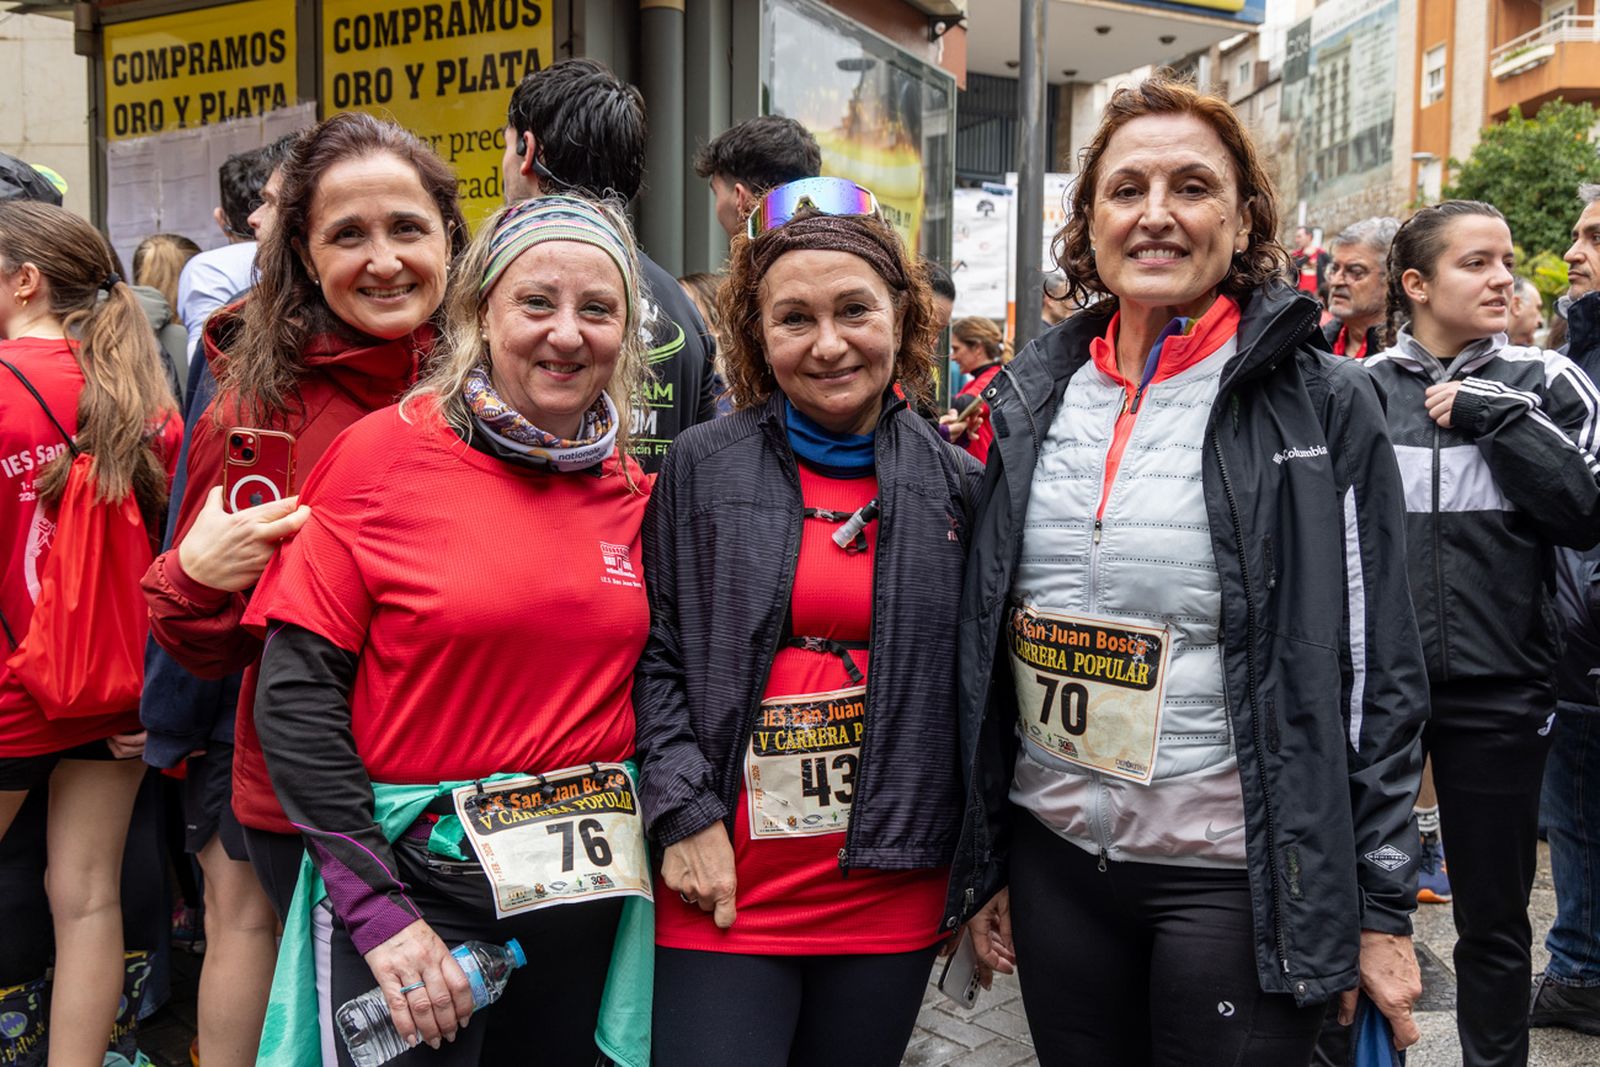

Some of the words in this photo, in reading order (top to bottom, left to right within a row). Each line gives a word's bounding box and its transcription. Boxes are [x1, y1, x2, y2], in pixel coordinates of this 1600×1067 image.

[334, 0, 542, 54] COMPRAMOS
[113, 29, 286, 86] COMPRAMOS
[334, 67, 393, 109] ORO
[405, 63, 424, 99] Y
[437, 48, 541, 96] PLATA
[114, 98, 164, 136] ORO
[174, 95, 190, 128] Y
[200, 82, 287, 126] PLATA
[449, 126, 506, 162] prec
[0, 449, 34, 478] IES
[35, 442, 66, 465] San
[1283, 445, 1328, 461] Columbia
[1023, 617, 1045, 640] San
[1050, 623, 1091, 647] Juan
[1096, 631, 1147, 656] Bosco
[1016, 635, 1067, 671] CARRERA
[1073, 651, 1149, 686] POPULAR
[763, 708, 787, 727] IES
[791, 707, 822, 725] San
[828, 702, 864, 721] Juan
[1036, 674, 1089, 736] 70
[759, 732, 769, 751] V
[775, 726, 849, 751] CARRERA
[853, 722, 864, 742] P
[509, 791, 541, 810] San
[801, 753, 860, 807] 43
[478, 813, 492, 830] V
[572, 790, 633, 811] POPULAR
[546, 818, 613, 873] 76
